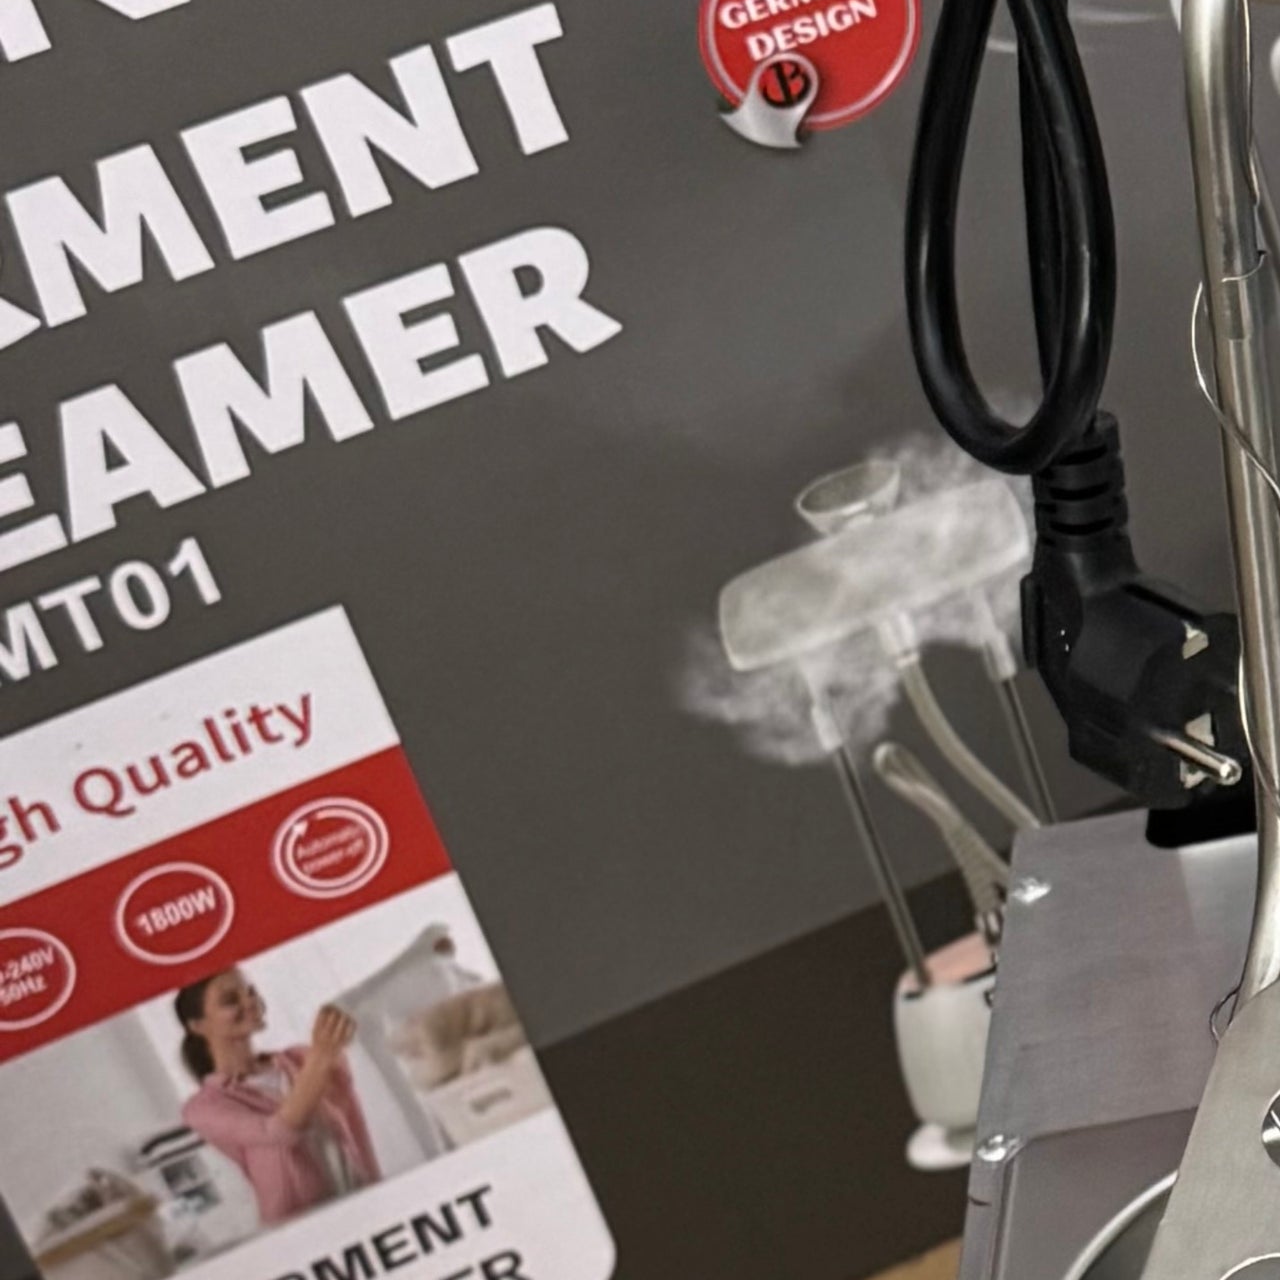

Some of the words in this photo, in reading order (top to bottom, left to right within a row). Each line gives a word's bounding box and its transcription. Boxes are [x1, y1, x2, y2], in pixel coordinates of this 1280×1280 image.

[0, 3, 570, 352] MENT
[73, 692, 311, 817] Quality
[134, 885, 217, 937] 1800W
